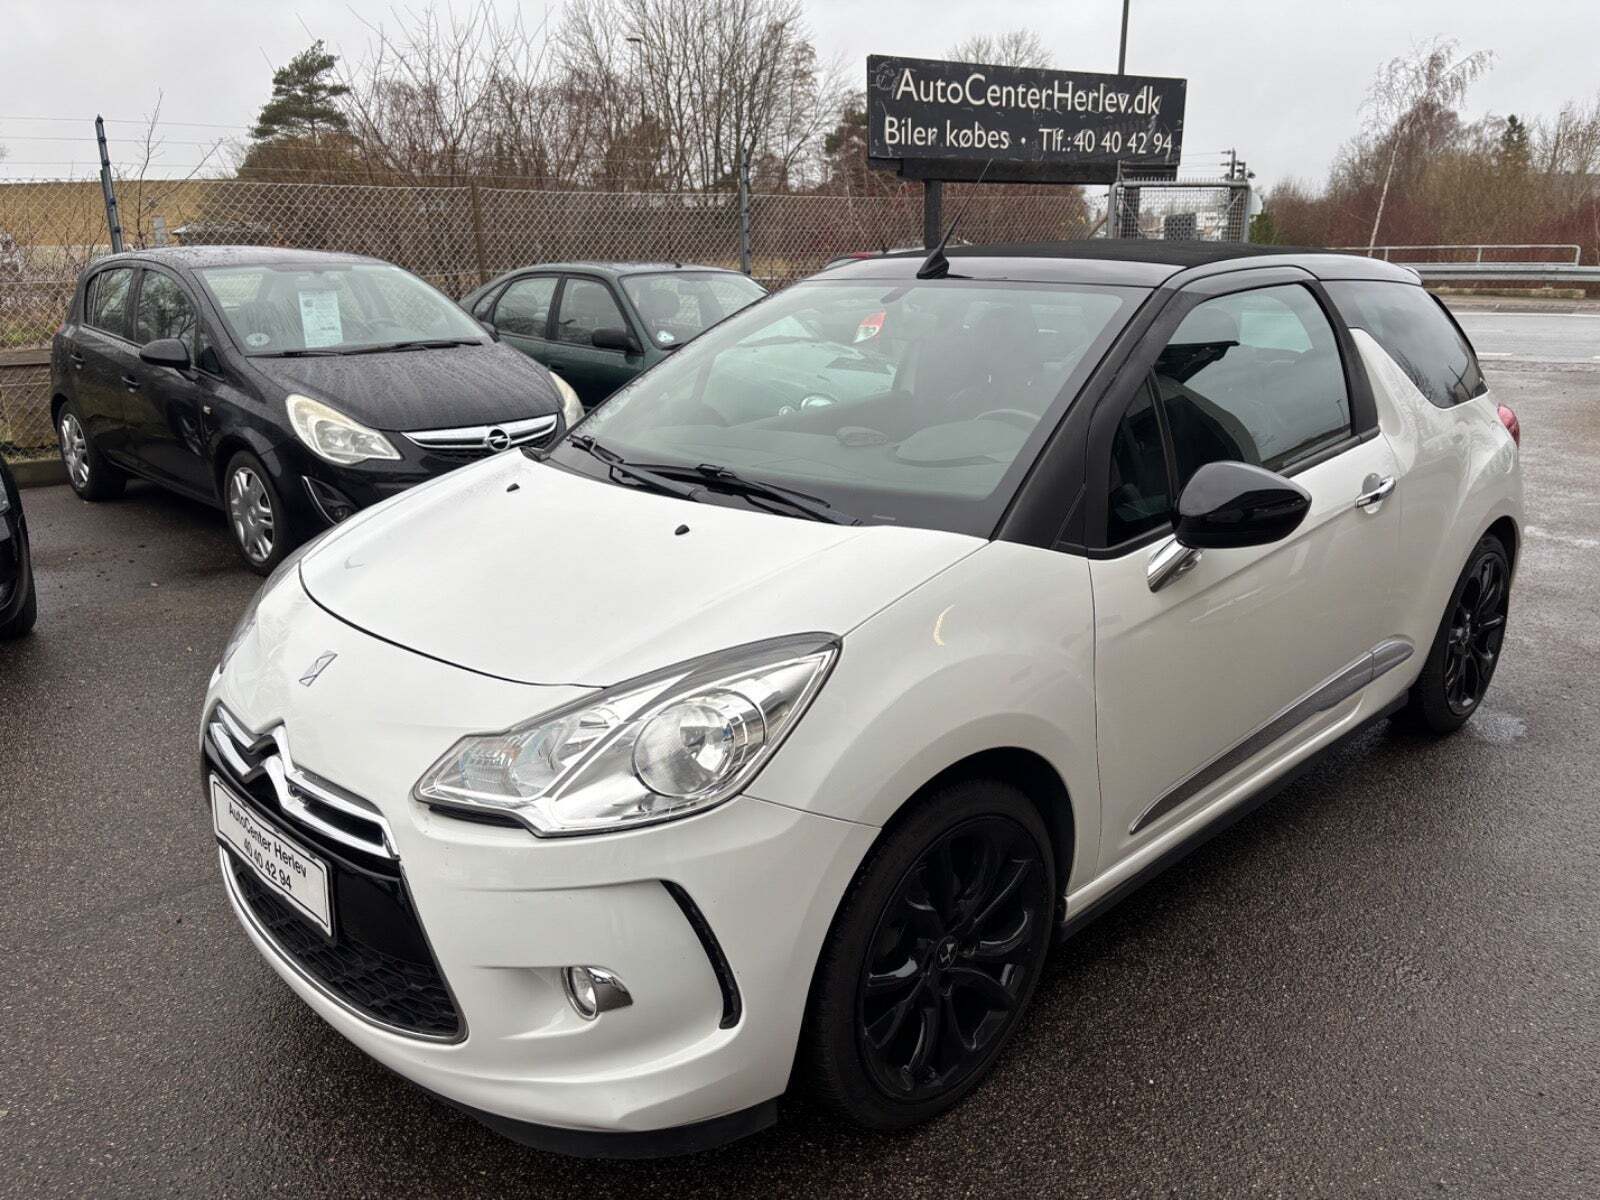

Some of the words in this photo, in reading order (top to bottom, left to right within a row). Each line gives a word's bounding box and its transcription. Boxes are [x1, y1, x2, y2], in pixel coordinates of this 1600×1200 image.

[895, 68, 1161, 115] AutoCenterHerlev.dk
[884, 116, 936, 147] Biler
[946, 118, 1010, 150] købes
[1100, 130, 1122, 153] 40
[1127, 132, 1147, 154] 42
[1153, 133, 1172, 154] 94
[229, 802, 272, 851] AutoCenter
[274, 841, 307, 878] Herlev
[254, 850, 263, 870] 40
[265, 860, 277, 880] 42
[279, 869, 292, 890] 94
